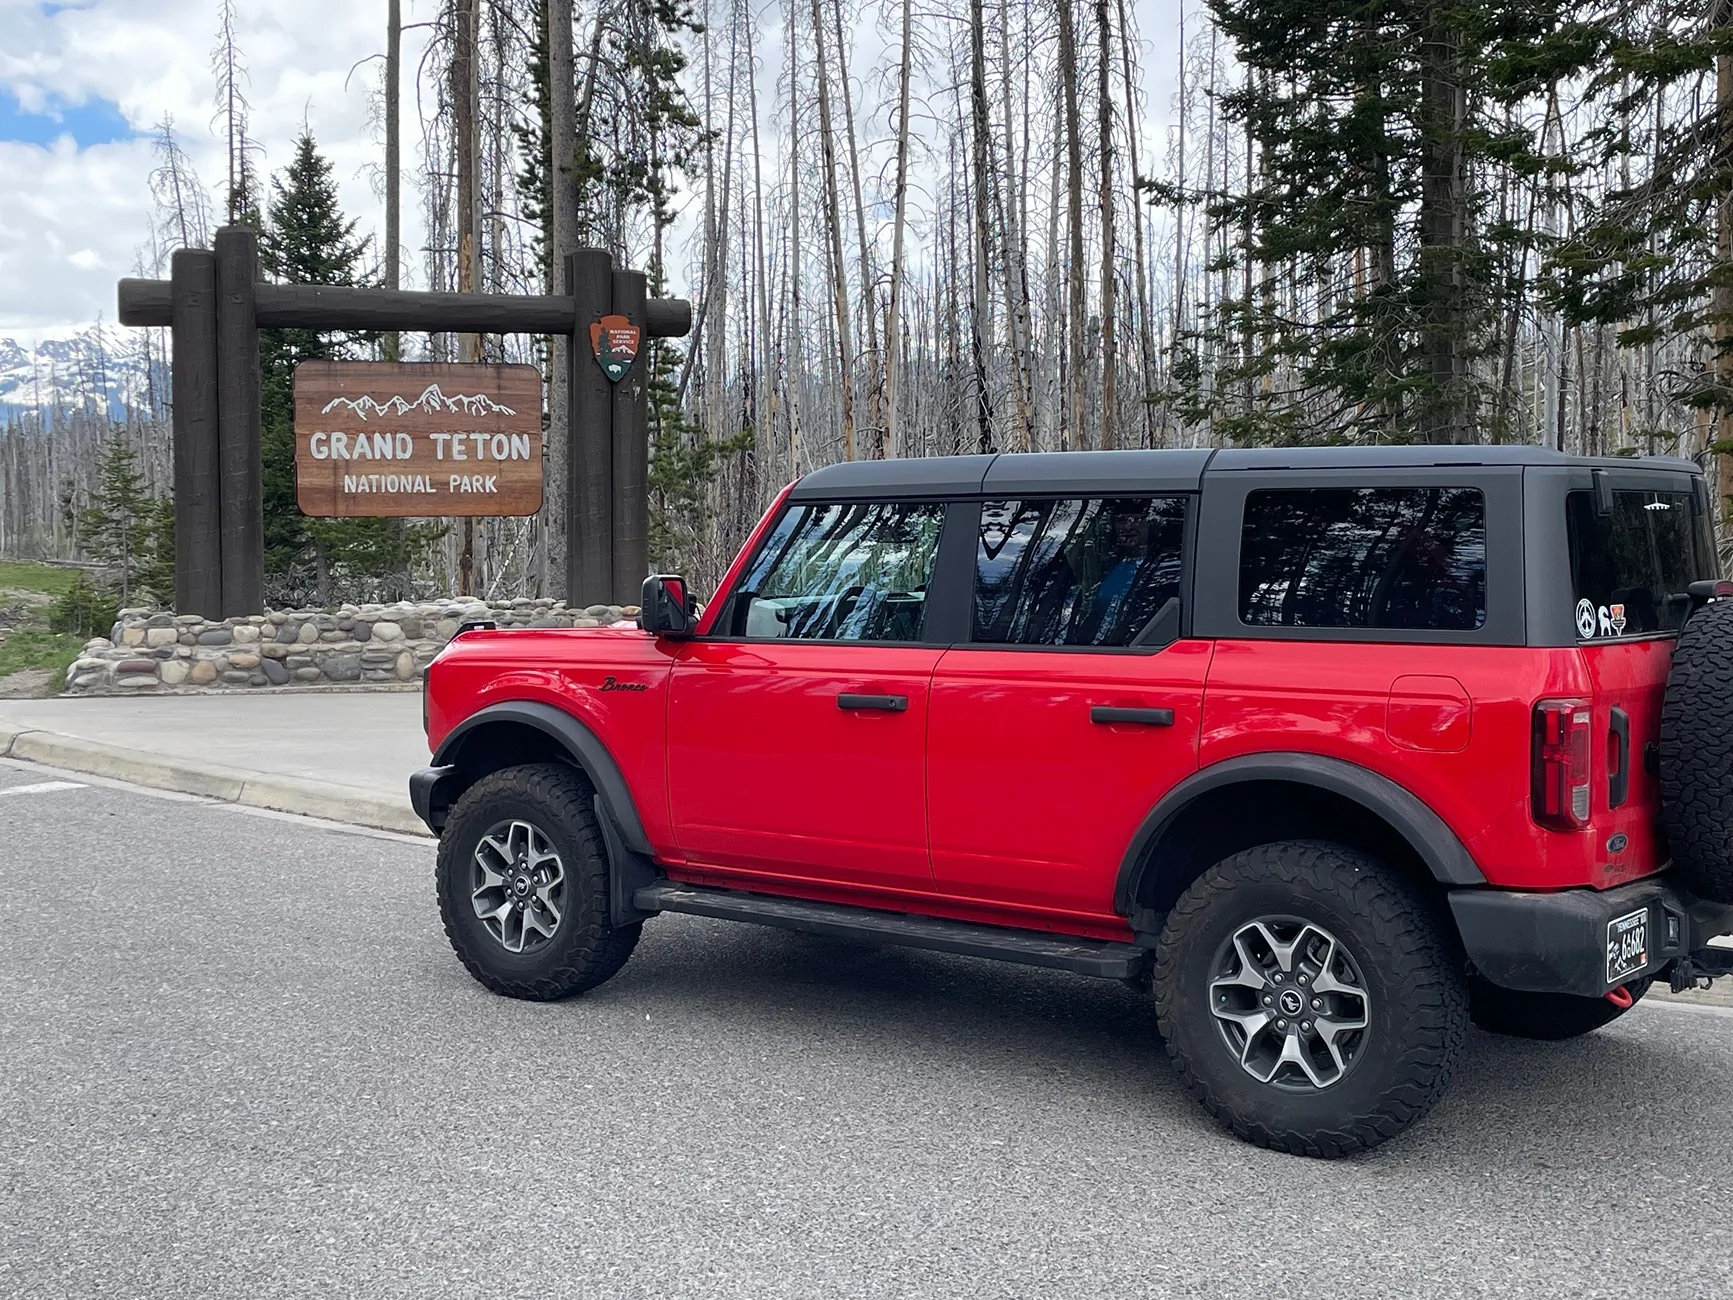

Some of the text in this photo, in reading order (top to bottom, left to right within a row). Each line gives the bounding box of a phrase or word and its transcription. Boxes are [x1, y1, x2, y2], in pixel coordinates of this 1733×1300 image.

[310, 432, 530, 460] GRAND TETON
[344, 474, 498, 494] NATIONAL PARK
[599, 676, 649, 691] Bronco
